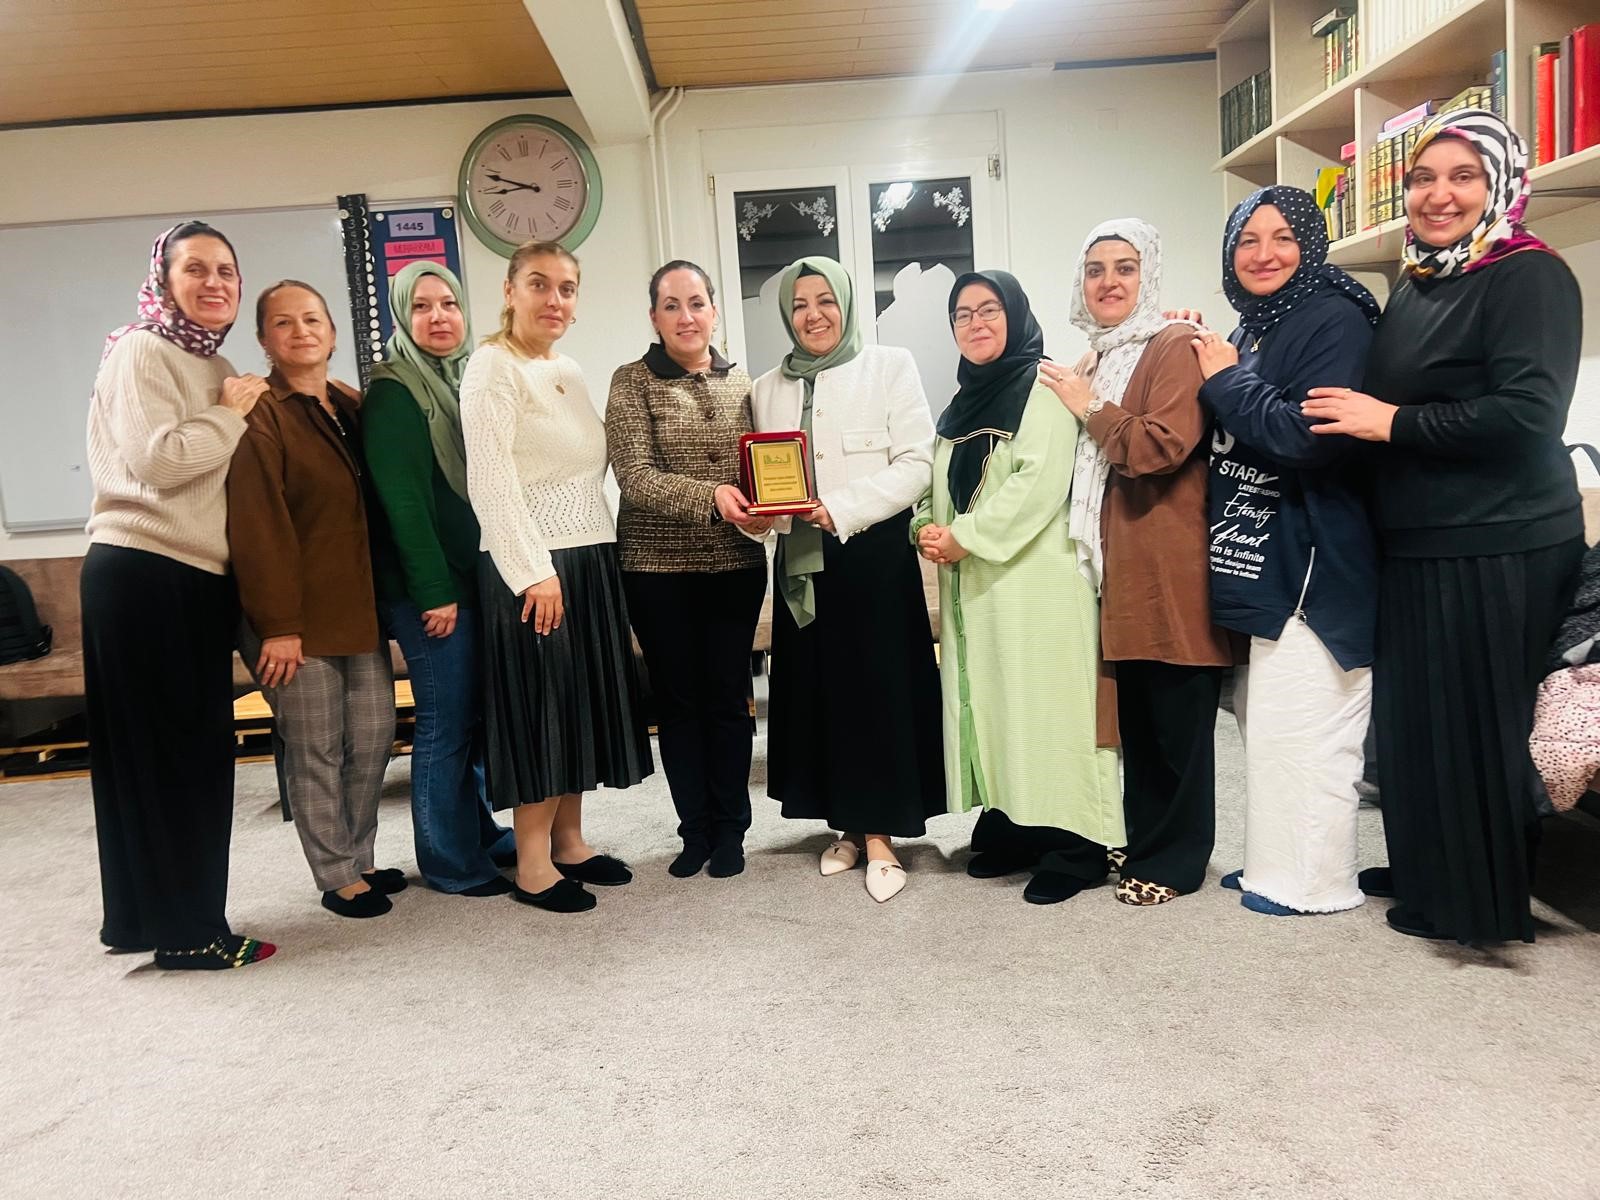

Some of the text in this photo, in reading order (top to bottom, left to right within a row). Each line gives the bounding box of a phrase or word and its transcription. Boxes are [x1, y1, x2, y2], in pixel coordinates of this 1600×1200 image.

[395, 222, 424, 231] 1445
[1223, 546, 1233, 556] is
[1233, 549, 1265, 563] infinite
